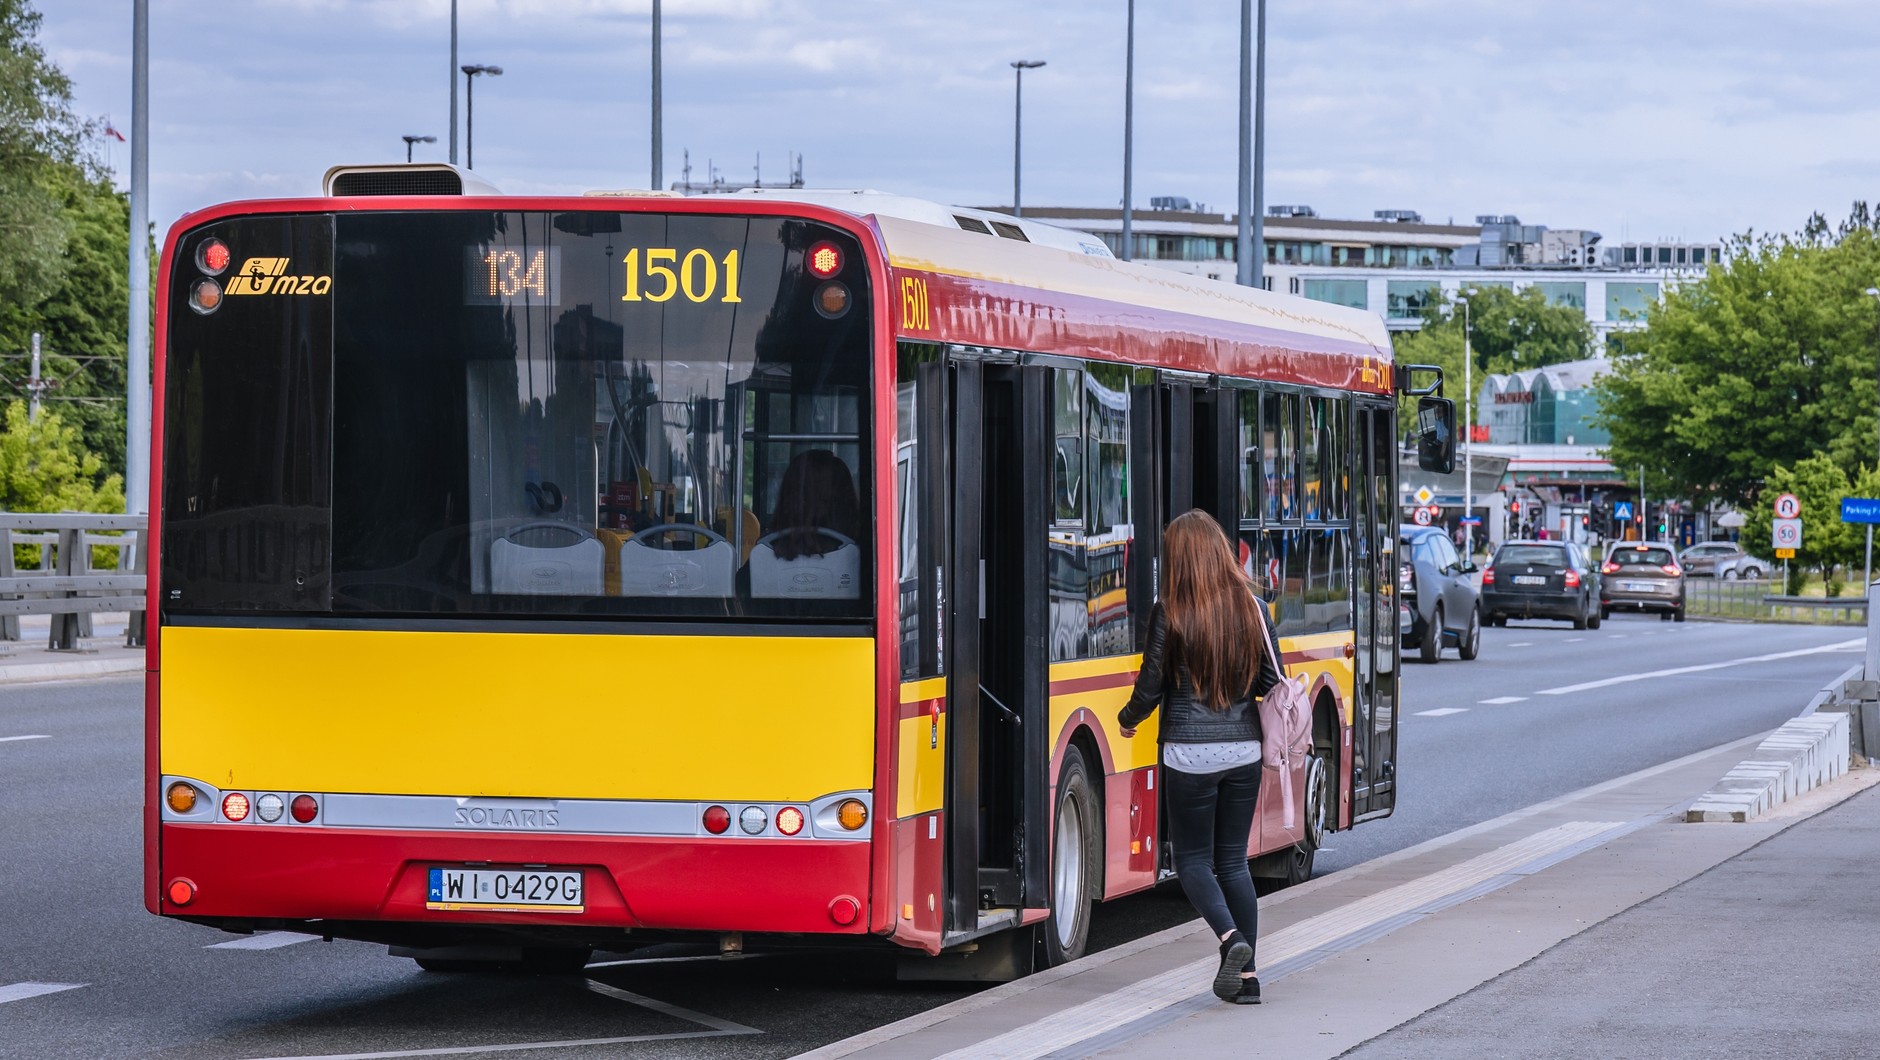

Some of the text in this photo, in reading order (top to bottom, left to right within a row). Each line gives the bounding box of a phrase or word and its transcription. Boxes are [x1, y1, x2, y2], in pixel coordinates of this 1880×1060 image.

[485, 250, 544, 296] 134
[621, 247, 742, 303] 1501
[271, 275, 332, 295] mza
[901, 276, 930, 330] 1501
[1845, 505, 1871, 516] Parking
[1781, 528, 1794, 539] 50
[455, 807, 560, 828] SOLARIS
[431, 888, 441, 897] PL
[447, 873, 577, 901] WI 0429G
